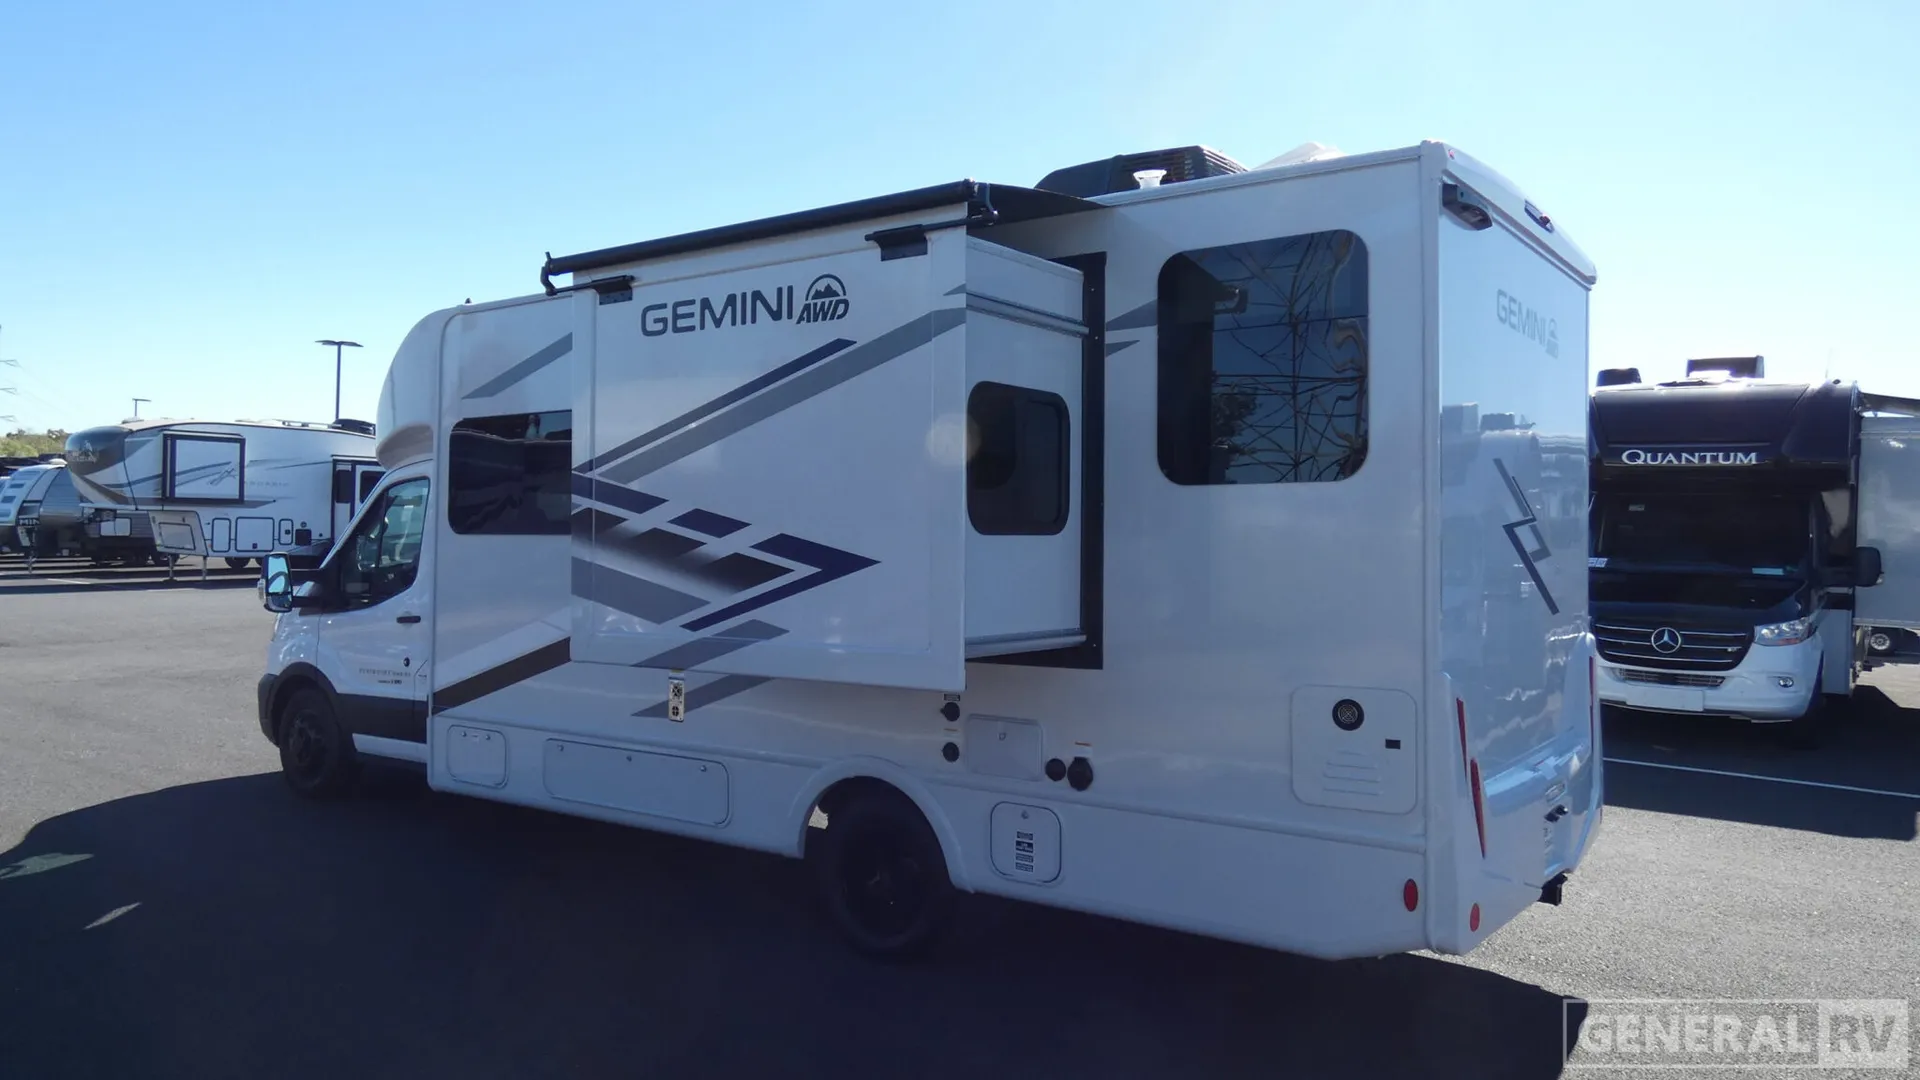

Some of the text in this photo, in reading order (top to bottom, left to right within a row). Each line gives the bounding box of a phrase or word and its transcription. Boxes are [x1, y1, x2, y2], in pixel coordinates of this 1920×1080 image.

[641, 285, 850, 337] GEMINI AWD
[1497, 288, 1546, 347] GEMINI
[1621, 449, 1758, 466] QUANTUM
